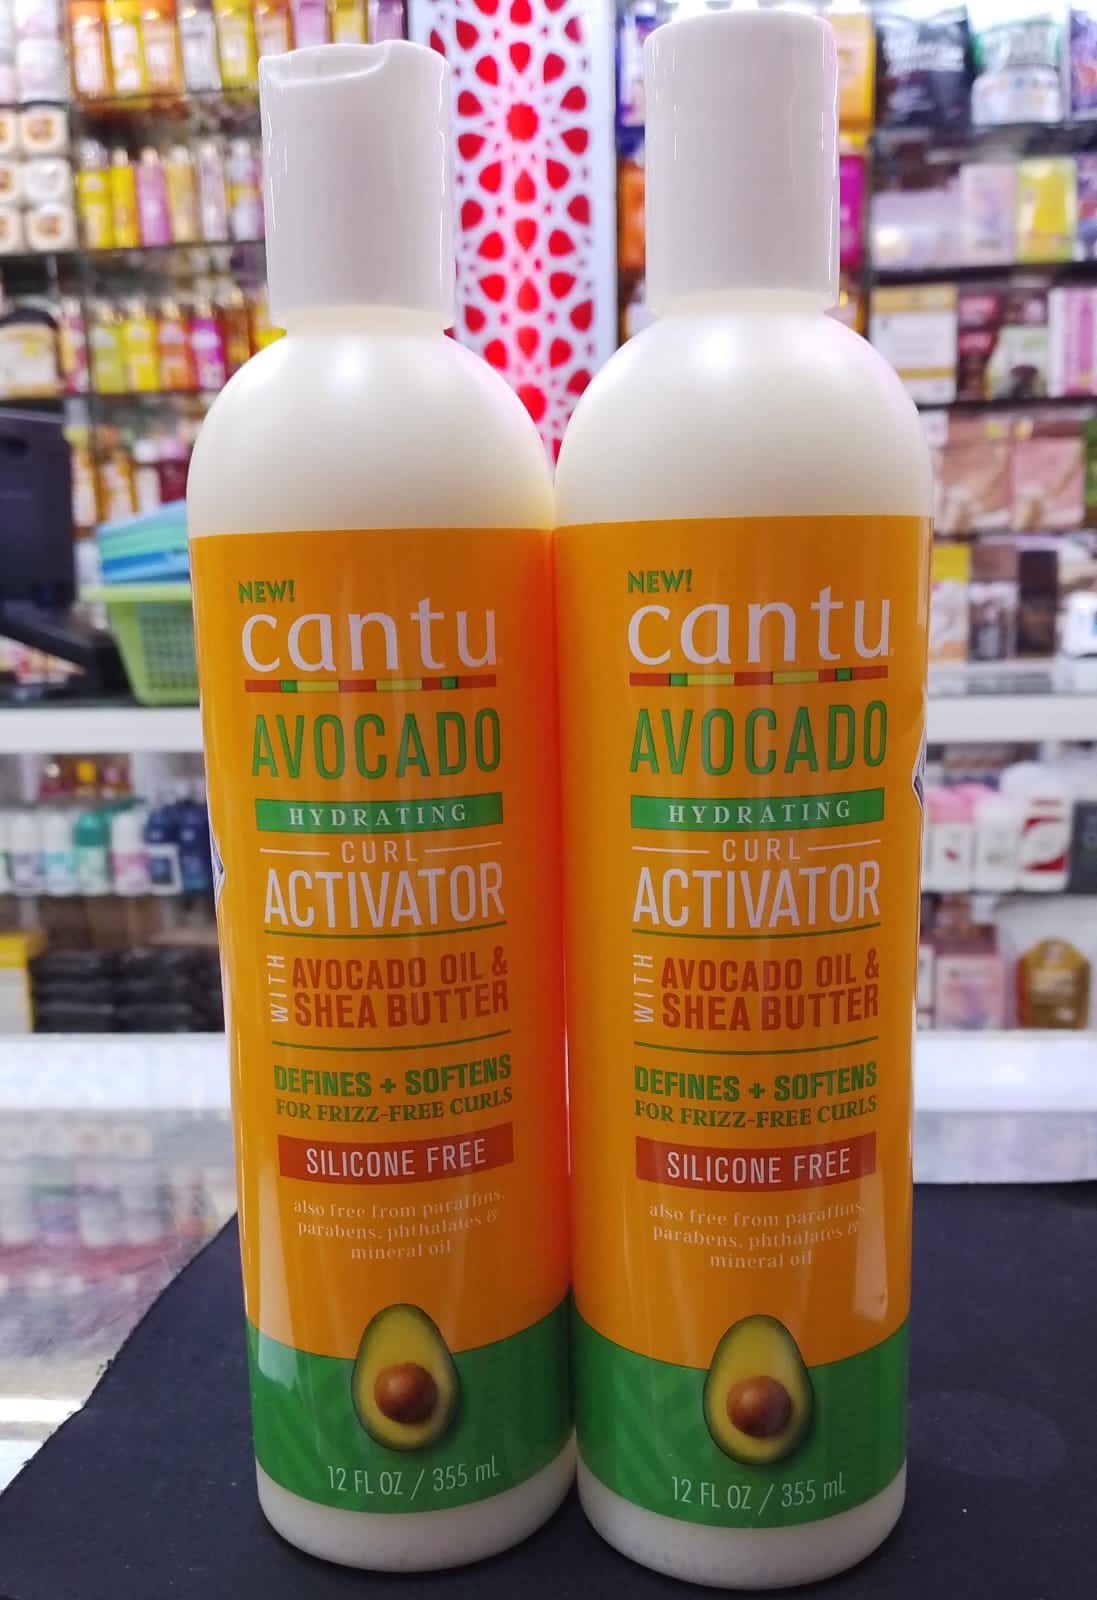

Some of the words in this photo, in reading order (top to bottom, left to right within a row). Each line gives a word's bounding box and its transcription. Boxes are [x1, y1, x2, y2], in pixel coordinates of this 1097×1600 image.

[238, 580, 295, 603] NEW!
[627, 569, 693, 593] NEW!
[241, 597, 496, 672] cantu
[628, 585, 891, 665] cantu
[252, 708, 500, 780] AVOCADO
[629, 700, 887, 776] AVOCADO
[289, 803, 465, 827] HYDRATING
[668, 800, 850, 824] HYDRATING
[341, 840, 419, 864] CURL
[722, 838, 800, 863] CURL
[264, 862, 505, 928] ACTIVATOR
[632, 860, 880, 928] ACTIVATOR
[266, 954, 288, 1023] WITH
[292, 957, 426, 991] AVOCADO
[440, 951, 483, 985] OIL
[491, 945, 508, 977] &
[633, 954, 654, 1023] WITH
[661, 957, 802, 993] AVOCADO
[815, 953, 856, 988] OIL
[864, 947, 879, 979] &
[295, 991, 378, 1028] SHEA
[387, 979, 510, 1028] BUTTER
[662, 992, 750, 1031] SHEA
[761, 983, 879, 1031] BUTTER
[273, 1064, 372, 1097] DEFINES
[380, 1077, 396, 1094] +
[405, 1053, 511, 1096] SOFTENS
[634, 1064, 740, 1102] DEFINES
[748, 1082, 765, 1100] +
[773, 1060, 877, 1102] SOFTENS
[275, 1098, 311, 1120] FOR
[317, 1100, 444, 1123] FRIZZ-FREE
[449, 1086, 513, 1116] CURLS
[634, 1099, 674, 1122] FOR
[680, 1106, 811, 1129] FRIZZ-FREE
[816, 1095, 877, 1124] CURLS
[305, 1147, 416, 1178] SILICONE
[426, 1138, 487, 1174] FREE
[667, 1151, 782, 1185] SILICONE
[793, 1147, 851, 1182] FREE
[294, 1200, 325, 1217] also
[330, 1202, 366, 1219] free
[371, 1201, 417, 1219] from
[387, 1215, 481, 1242] phthalates
[649, 1203, 684, 1221] also
[689, 1208, 728, 1226] free
[733, 1211, 779, 1228] from
[351, 1242, 423, 1260] mineral
[428, 1239, 451, 1256] oil
[710, 1251, 784, 1269] mineral
[790, 1250, 813, 1266] oil
[749, 1227, 843, 1251] phthalates
[327, 1465, 348, 1492] 12
[354, 1470, 374, 1495] FL
[379, 1471, 404, 1496] OZ
[410, 1469, 425, 1501] /
[432, 1463, 468, 1492] 355
[475, 1455, 501, 1483] mL
[671, 1475, 692, 1503] 12
[700, 1482, 721, 1508] FL
[727, 1485, 752, 1510] OZ
[757, 1483, 775, 1517] /
[781, 1479, 816, 1508] 355
[823, 1472, 846, 1500] mL
